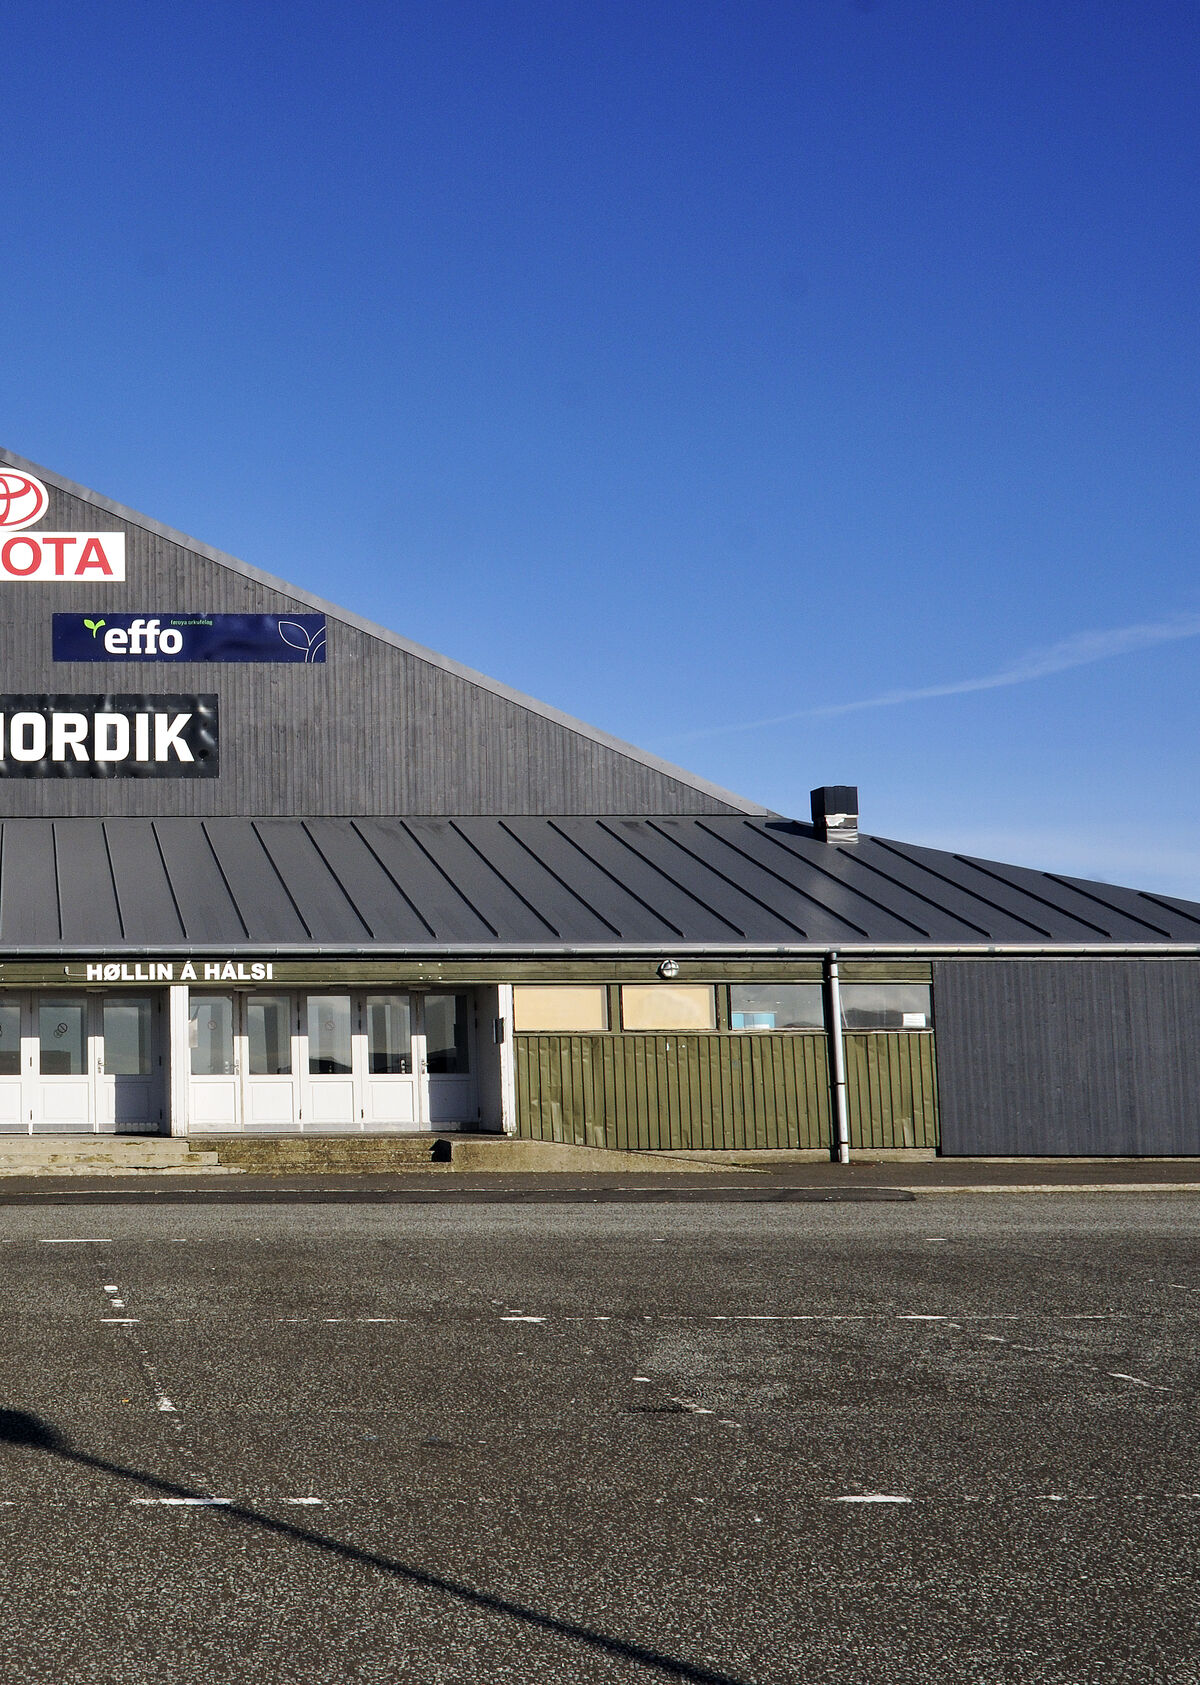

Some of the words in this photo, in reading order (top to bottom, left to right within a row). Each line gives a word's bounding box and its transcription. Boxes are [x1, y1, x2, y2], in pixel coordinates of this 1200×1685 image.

[104, 619, 183, 655] effo
[86, 963, 173, 981] HØLLIN
[180, 960, 197, 980] Á
[204, 960, 273, 980] HÁLSI
